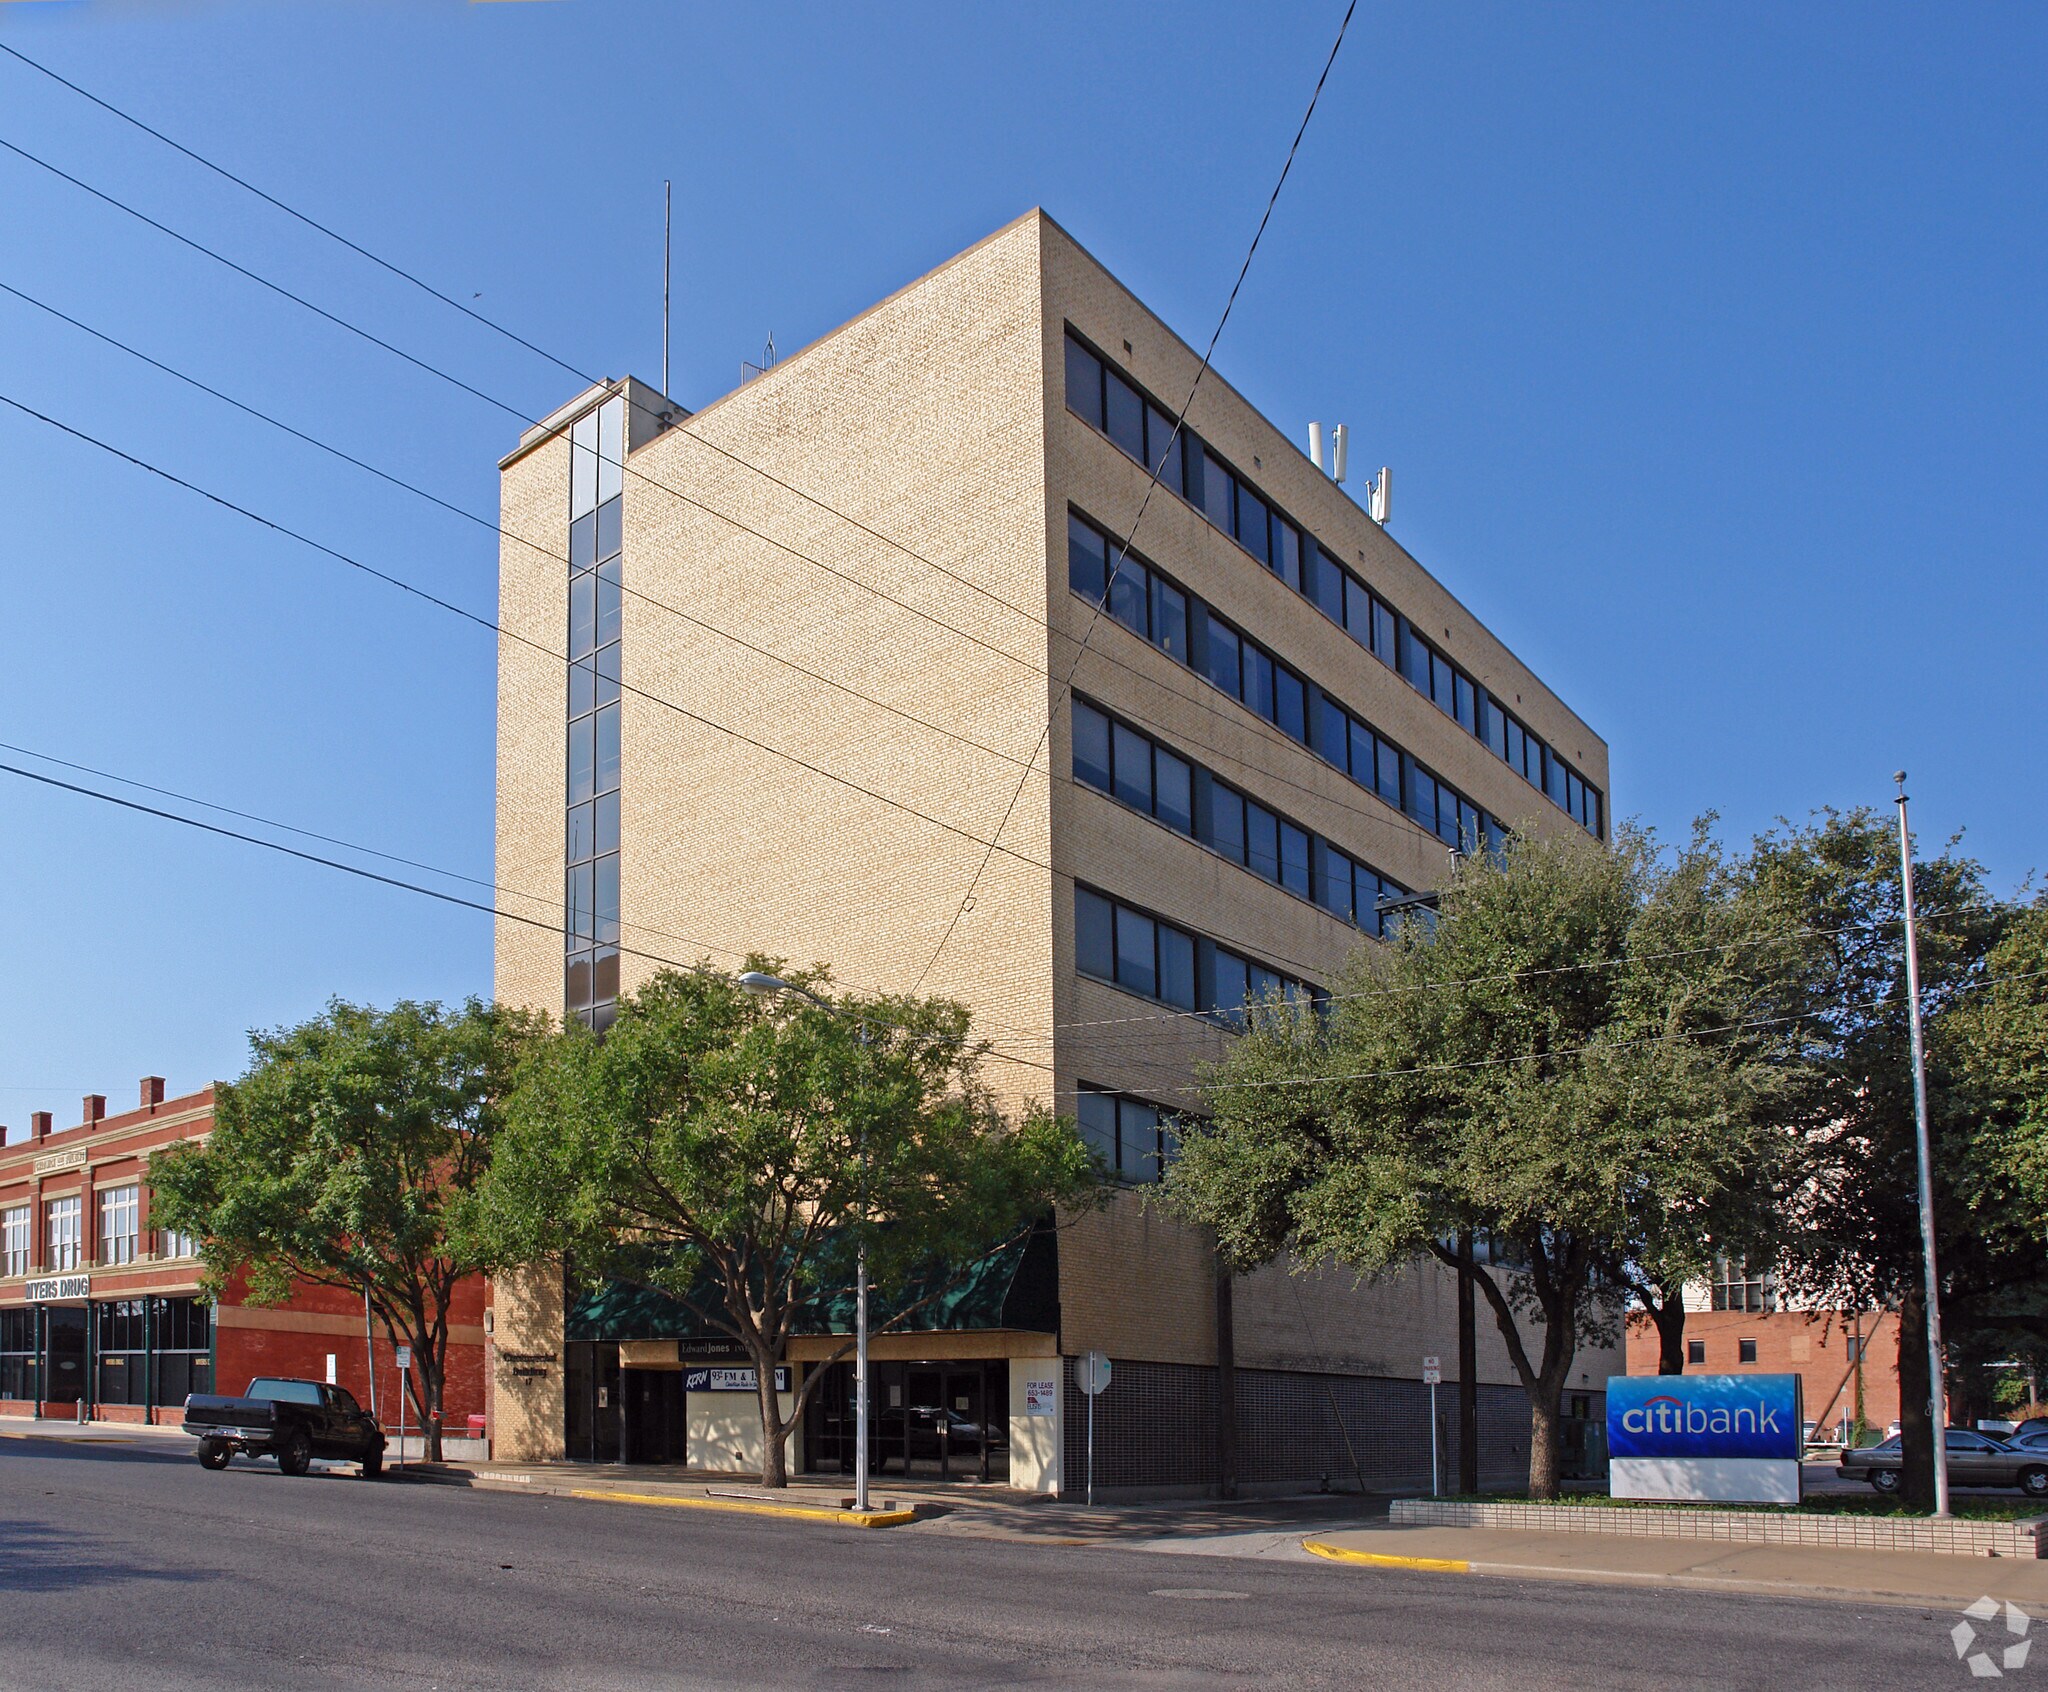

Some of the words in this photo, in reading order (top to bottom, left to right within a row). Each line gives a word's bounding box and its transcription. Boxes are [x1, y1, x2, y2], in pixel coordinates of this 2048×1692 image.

[26, 1280, 58, 1299] MYERS
[60, 1277, 88, 1297] DRUG
[686, 1369, 709, 1389] KCRN
[724, 1371, 737, 1381] FM
[1622, 1400, 1780, 1434] citibank
